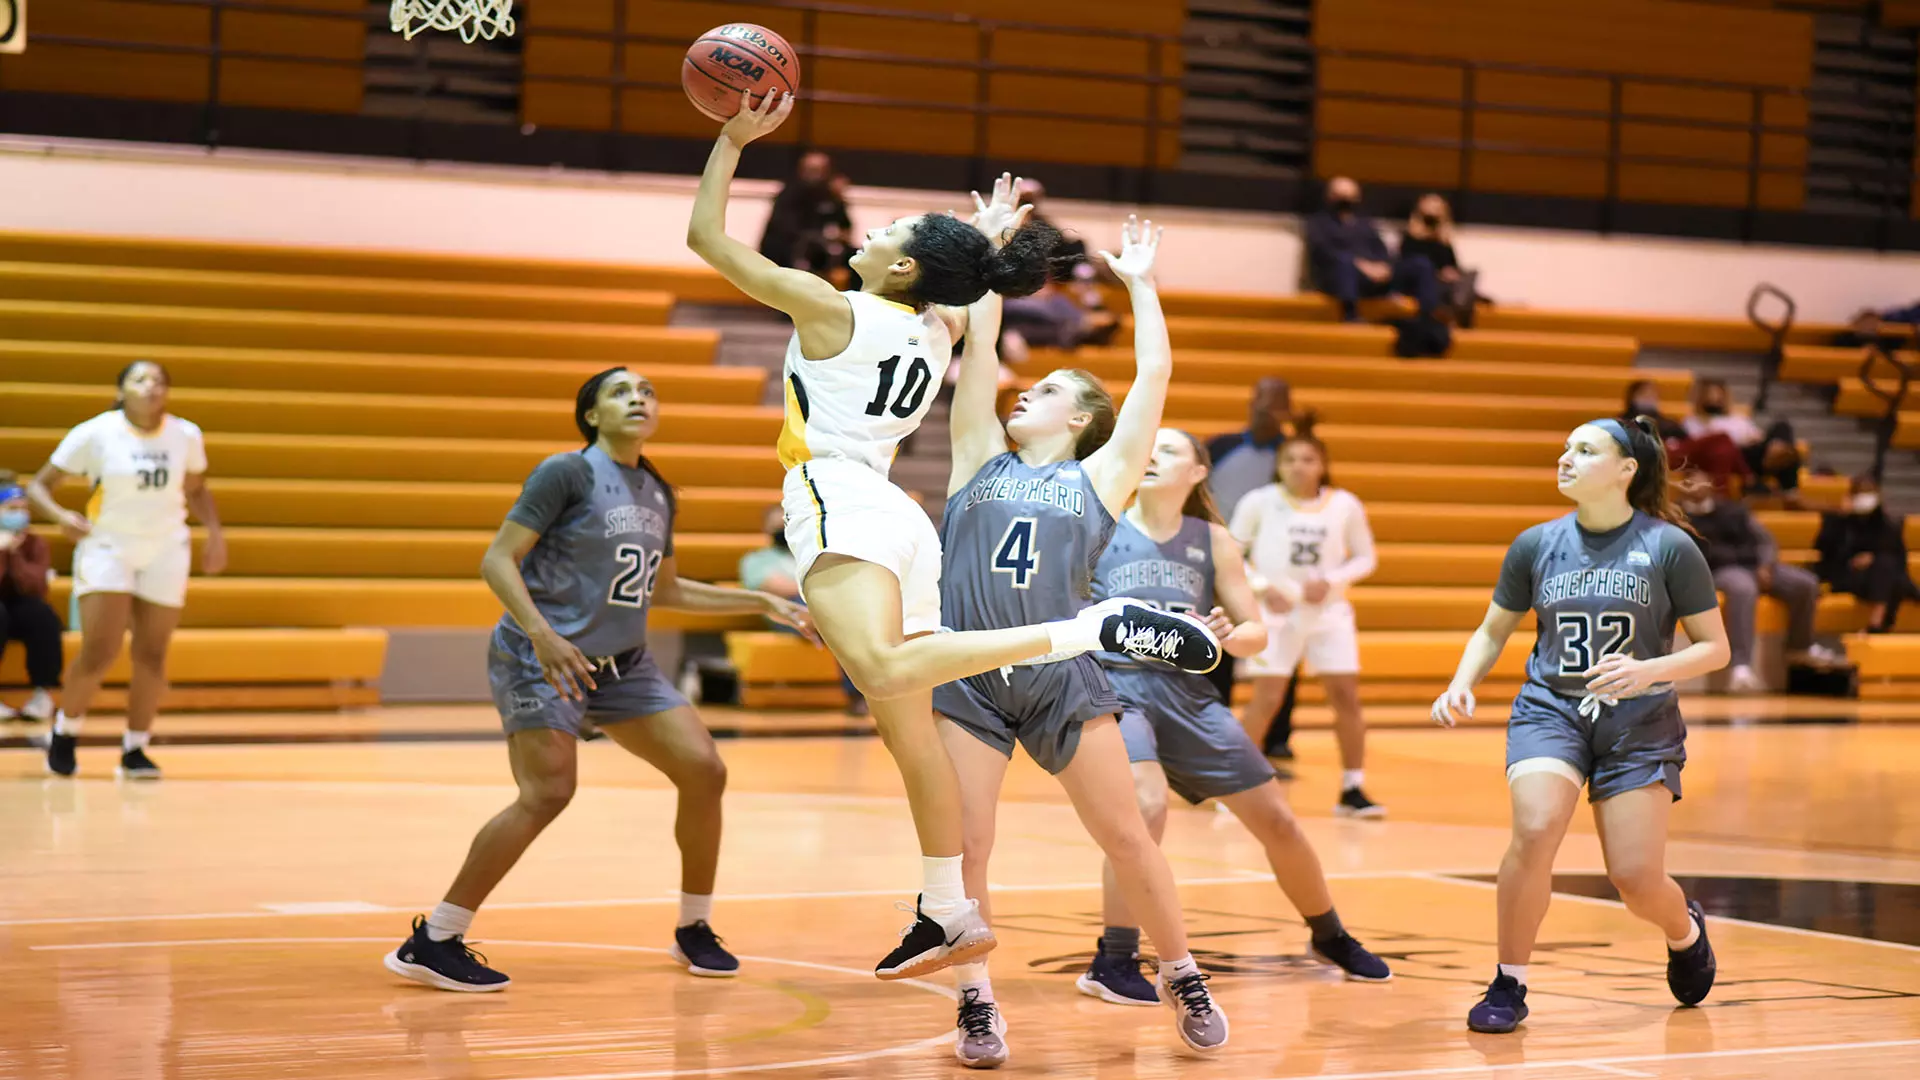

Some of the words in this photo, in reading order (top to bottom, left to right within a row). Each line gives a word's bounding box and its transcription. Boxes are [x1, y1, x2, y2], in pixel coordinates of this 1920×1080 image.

[708, 47, 765, 82] NCAA
[864, 355, 932, 419] 10
[136, 468, 169, 491] 30
[965, 476, 1084, 517] SHEPHERD
[604, 504, 664, 540] SHEPHE
[991, 516, 1040, 589] 4
[1289, 542, 1321, 567] 25
[1543, 567, 1651, 608] SHEPHERD
[1556, 611, 1635, 676] 32
